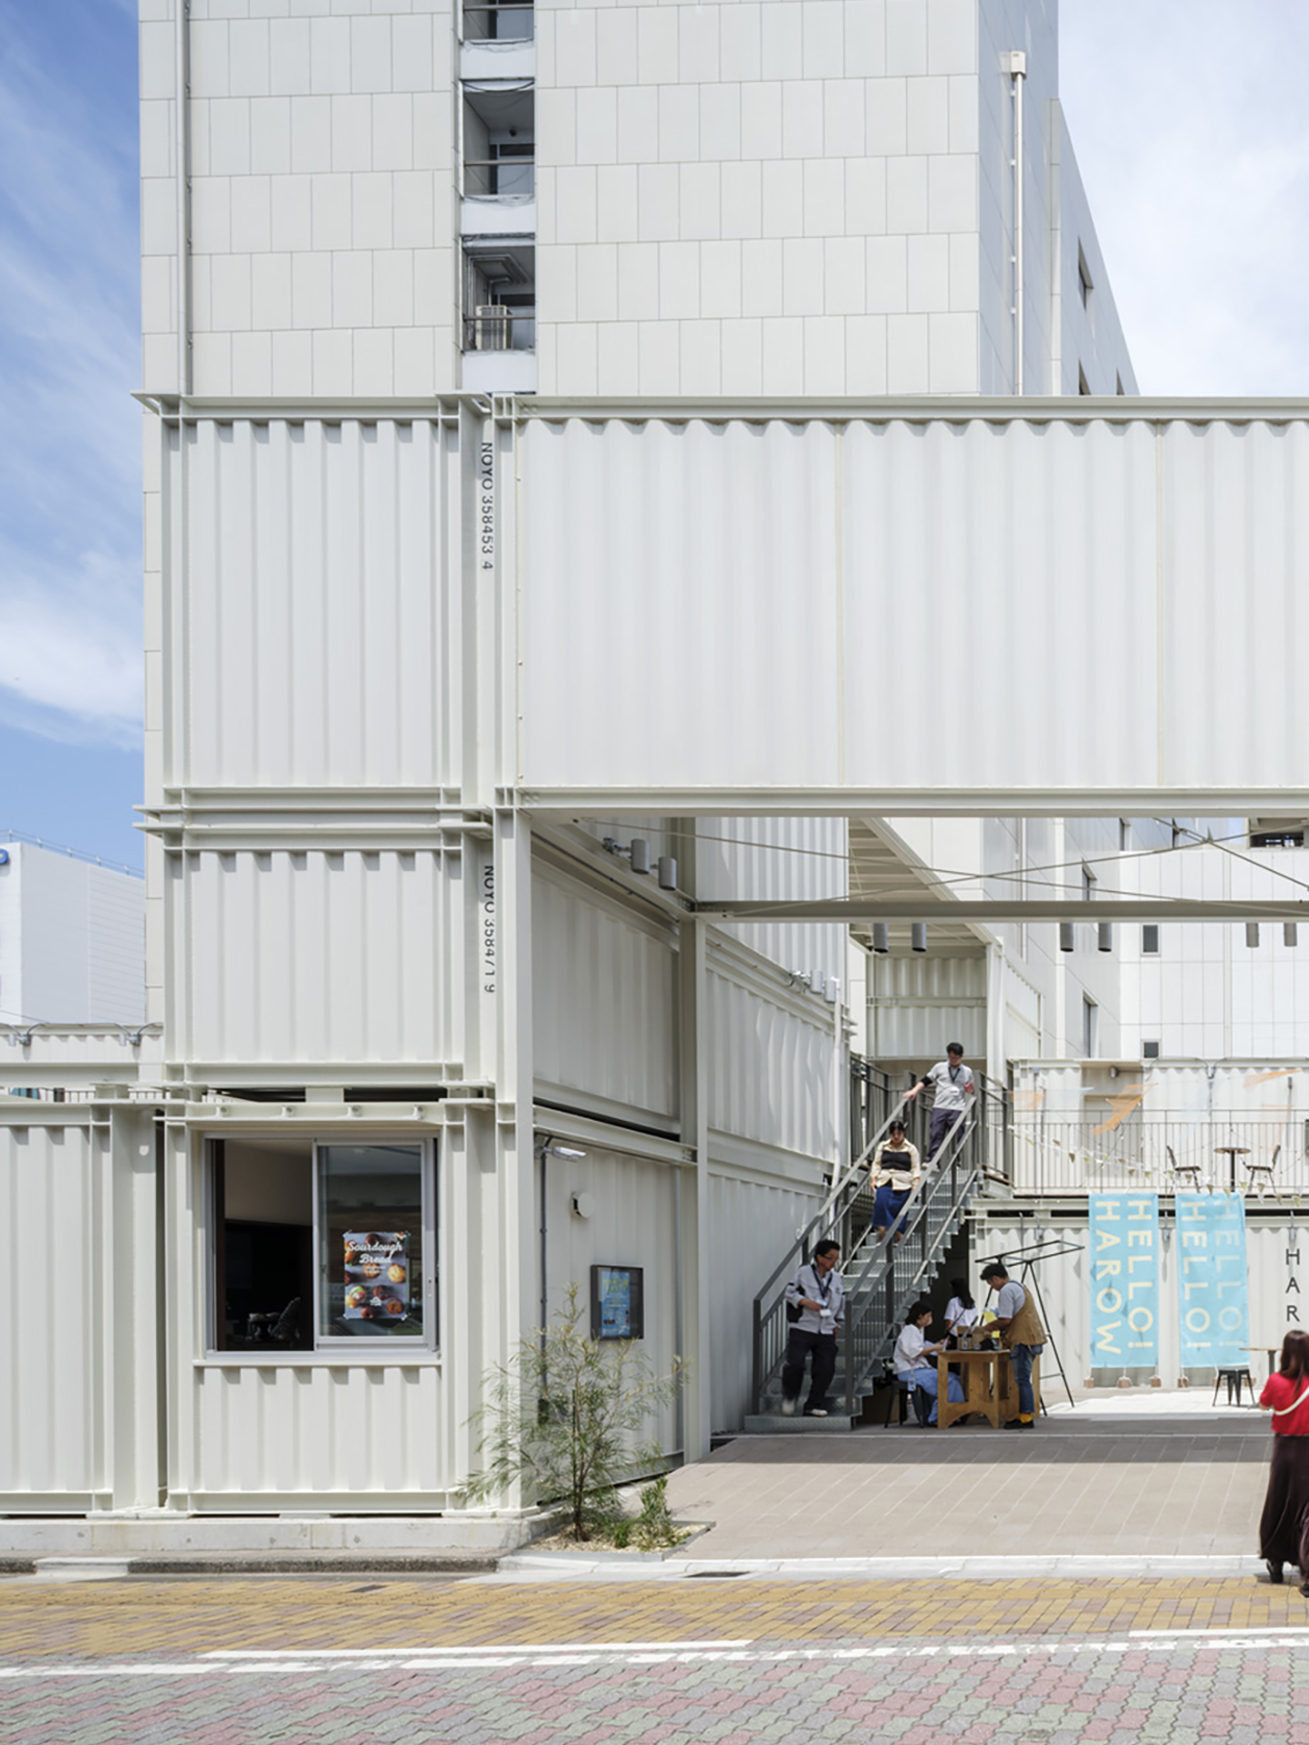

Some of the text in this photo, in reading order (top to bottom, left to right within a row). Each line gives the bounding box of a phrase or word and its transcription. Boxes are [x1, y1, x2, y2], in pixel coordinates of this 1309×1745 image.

[480, 442, 494, 570] NOYO 358453 4
[483, 865, 495, 913] NOYO
[347, 1241, 402, 1255] Sourdough
[359, 1252, 392, 1264] Bread
[1095, 1200, 1122, 1355] HAROW
[1127, 1200, 1154, 1348] HELLO!
[1181, 1200, 1212, 1348] HELLO!
[1214, 1199, 1244, 1347] HELLO!
